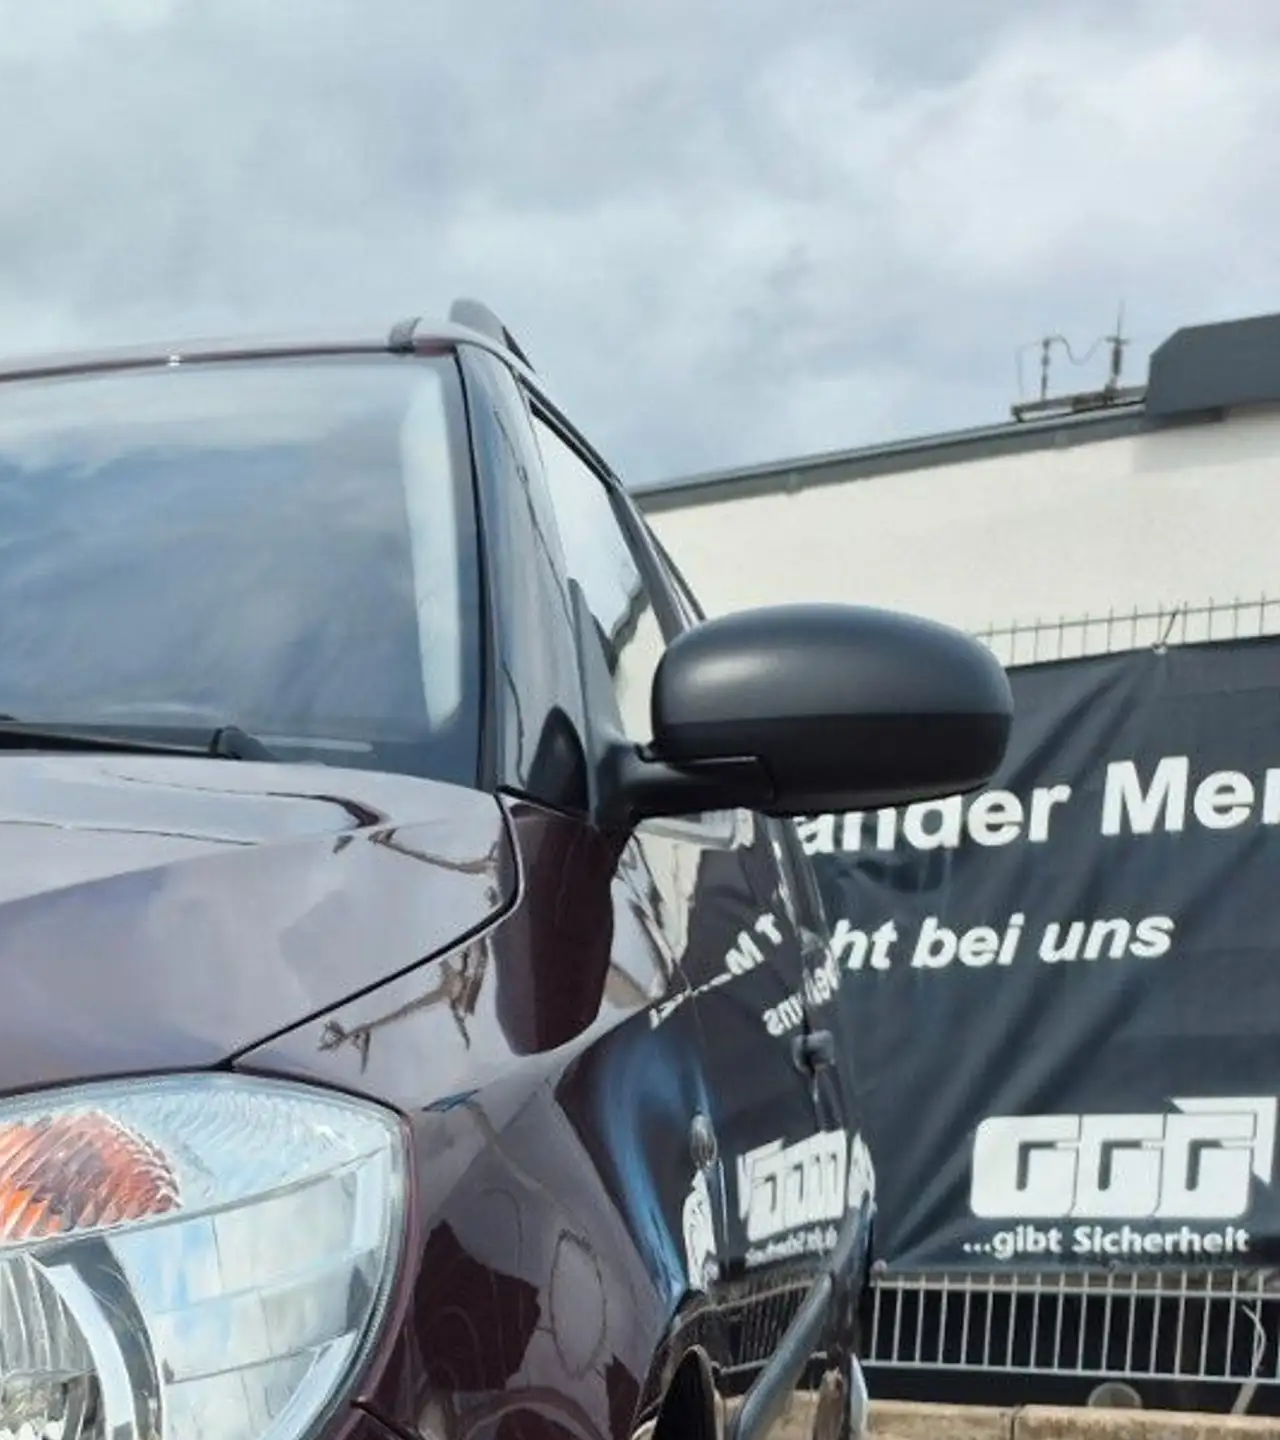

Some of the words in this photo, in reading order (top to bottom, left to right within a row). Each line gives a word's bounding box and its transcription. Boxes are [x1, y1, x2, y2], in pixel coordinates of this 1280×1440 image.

[795, 783, 1071, 856] ander
[830, 918, 897, 970] ht
[911, 913, 1024, 968] bei
[1040, 914, 1174, 964] uns
[970, 1106, 1262, 1218] GGG
[1072, 1225, 1251, 1253] Sicherheit
